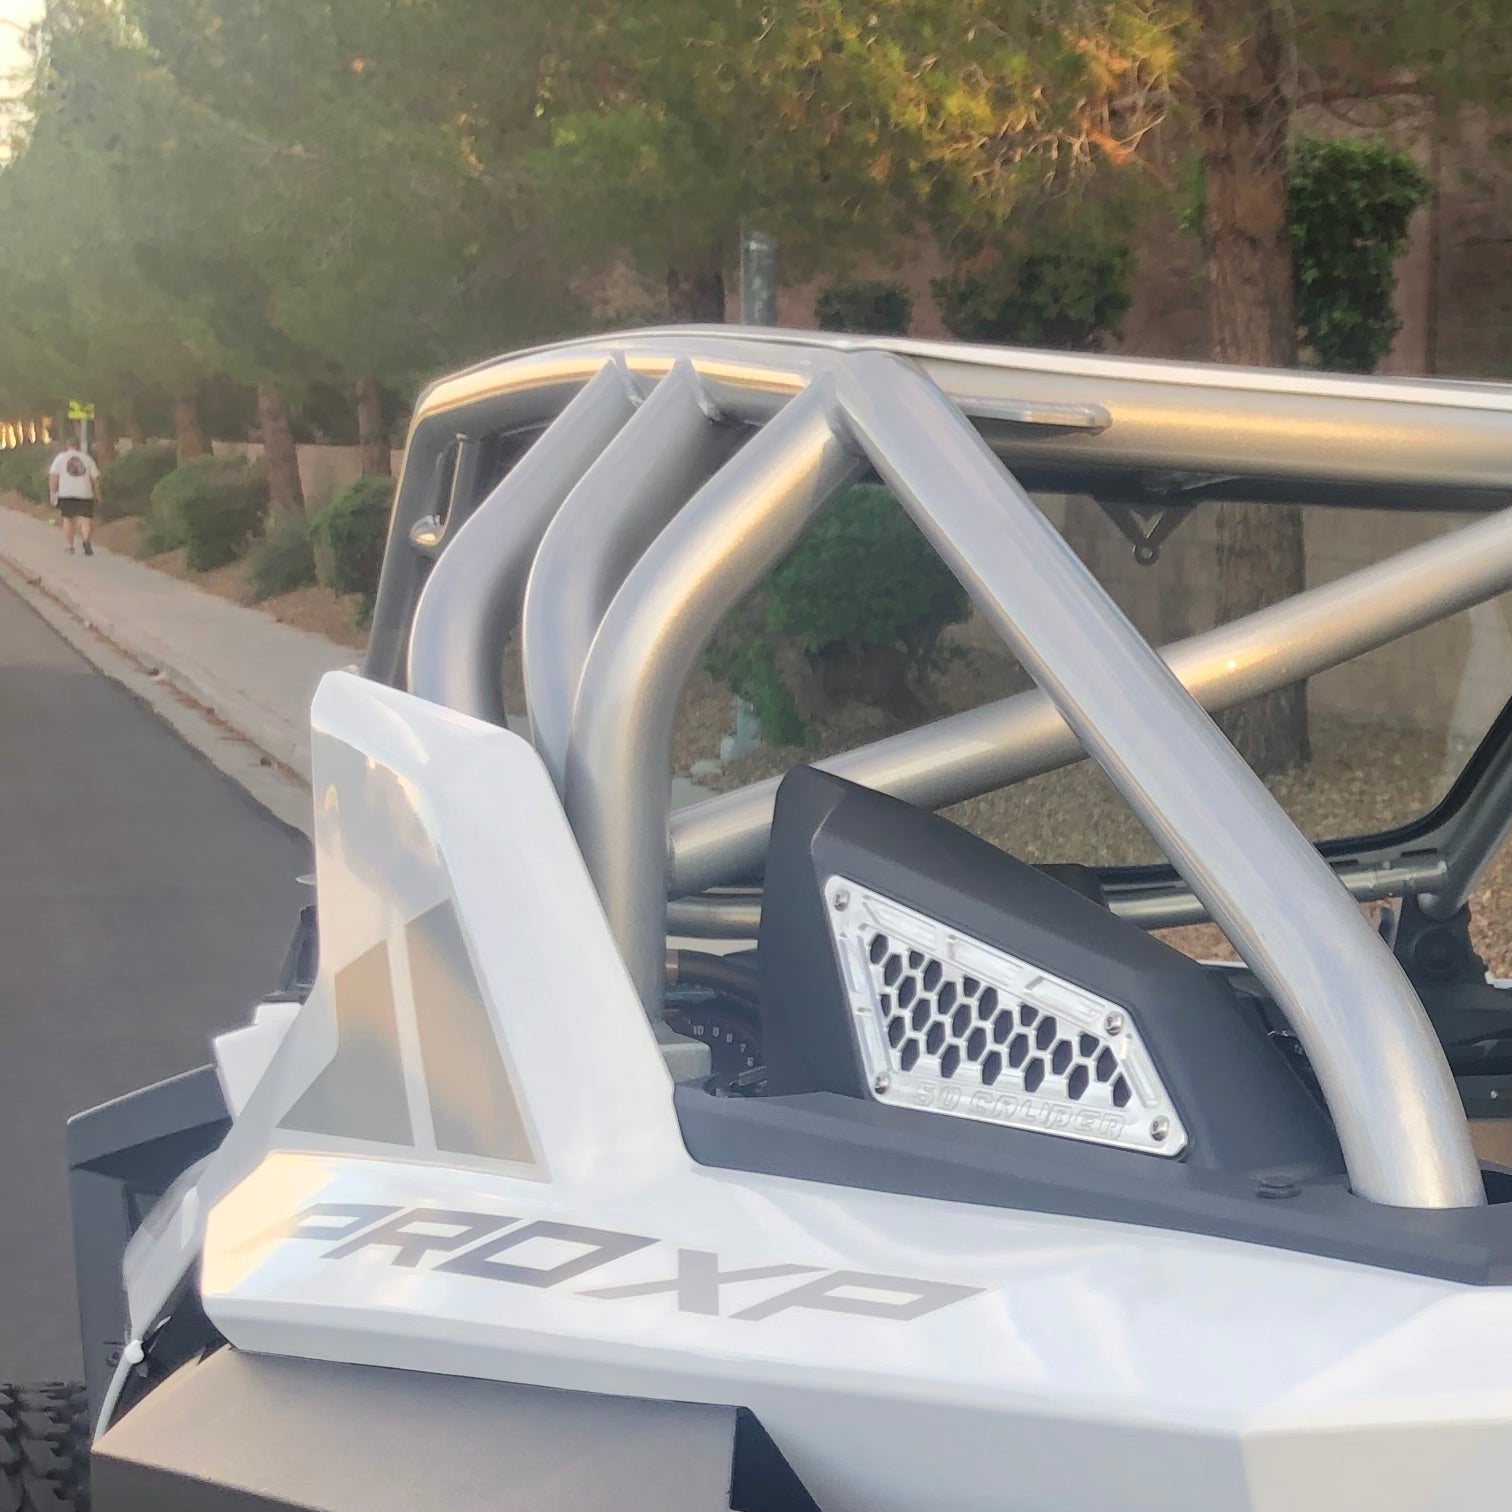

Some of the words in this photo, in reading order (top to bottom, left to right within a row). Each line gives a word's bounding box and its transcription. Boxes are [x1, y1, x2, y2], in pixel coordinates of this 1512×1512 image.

[970, 1090, 1126, 1140] CALIBER
[228, 1203, 662, 1288] PRO
[574, 1248, 988, 1322] XP
